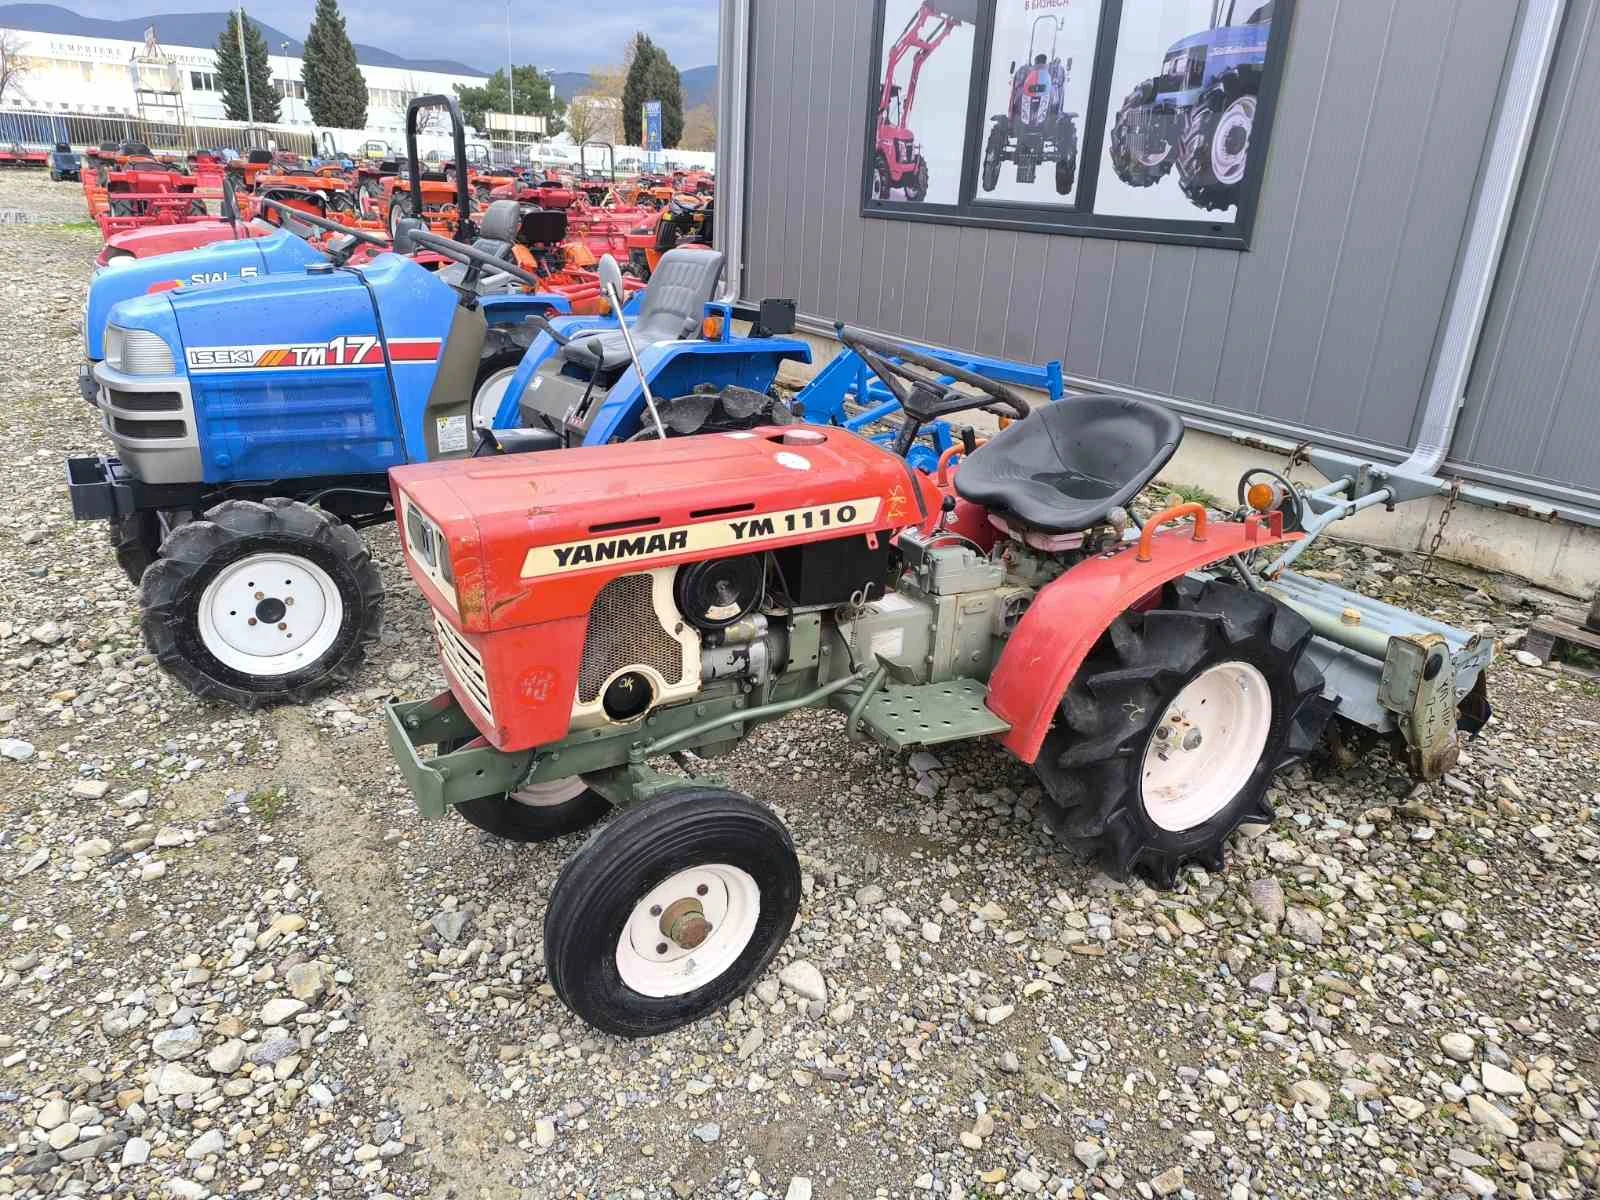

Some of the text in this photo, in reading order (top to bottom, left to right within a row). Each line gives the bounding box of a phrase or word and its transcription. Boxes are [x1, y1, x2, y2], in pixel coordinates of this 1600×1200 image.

[190, 336, 377, 366] ISEKI TM17
[553, 504, 857, 567] YANMAR YM 1110
